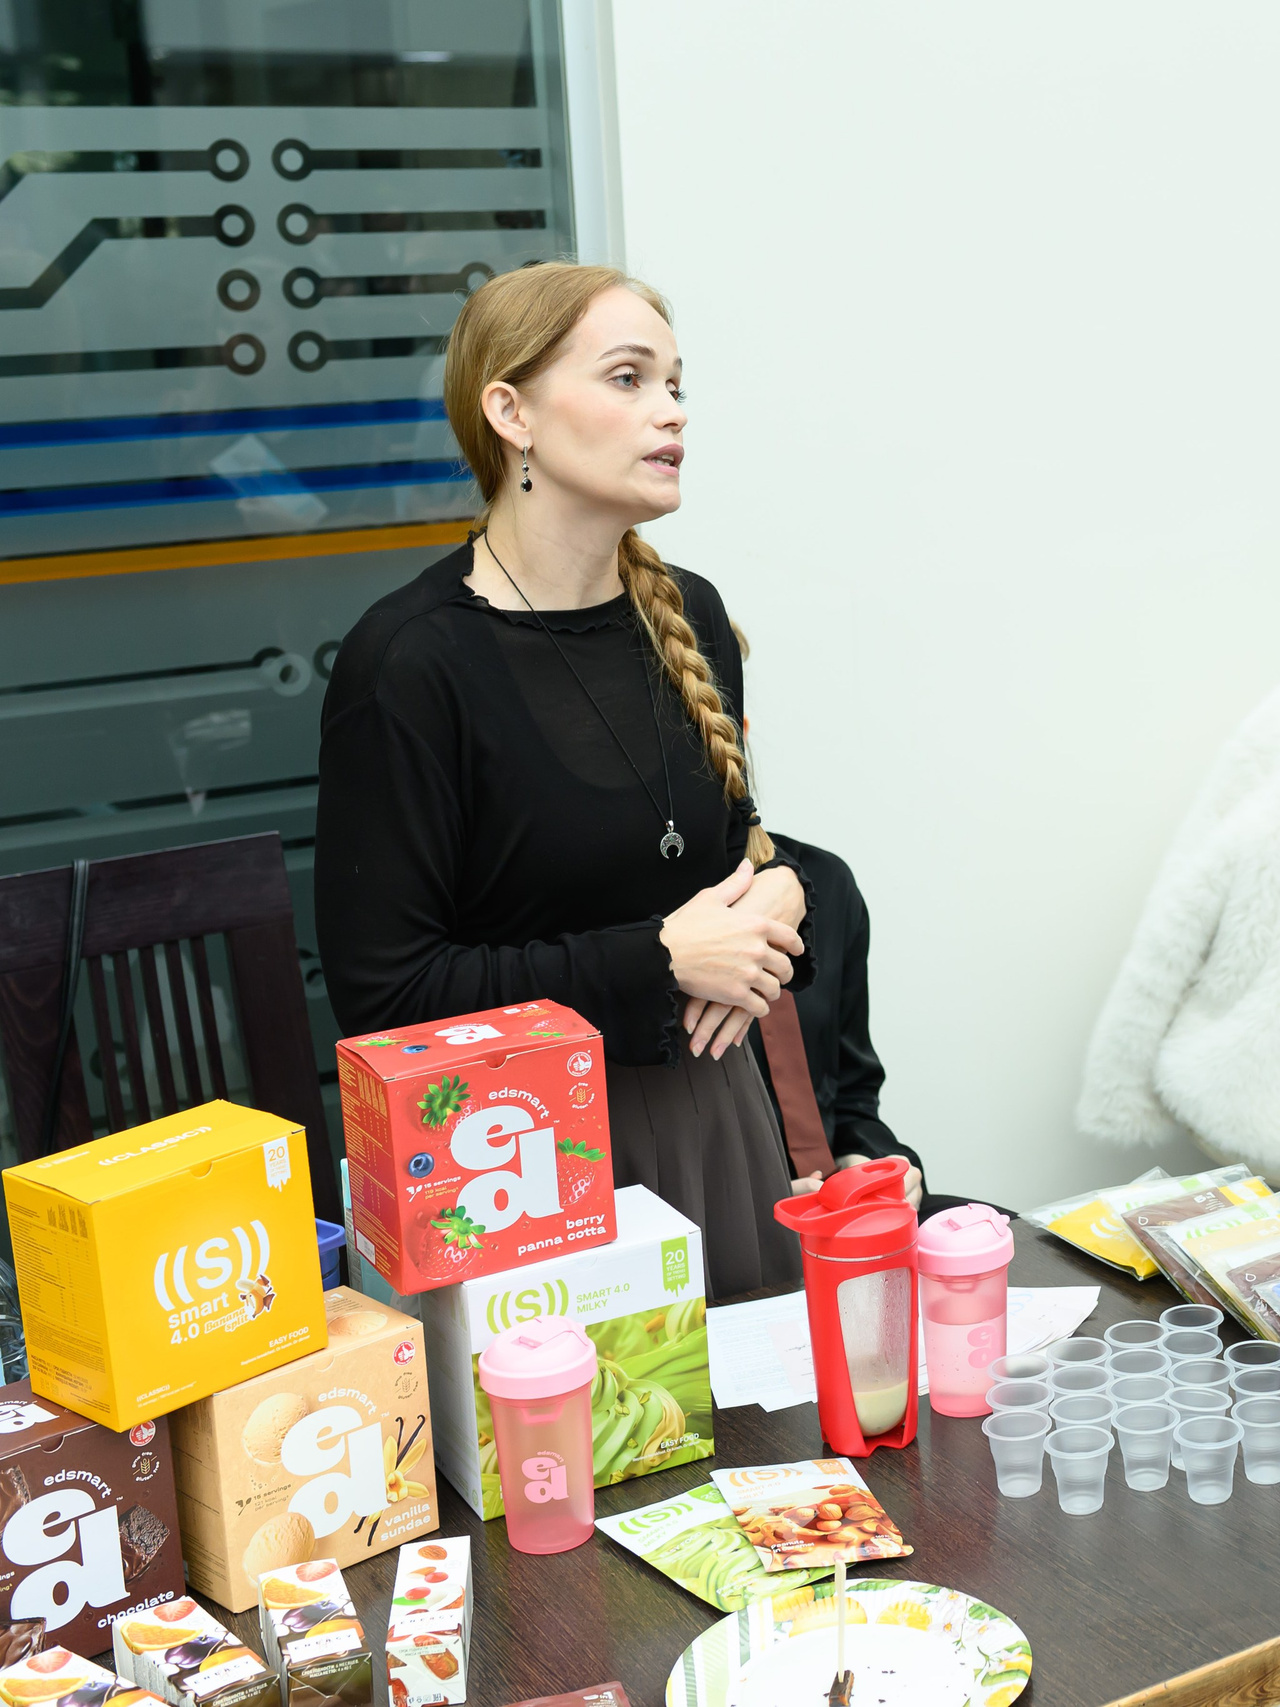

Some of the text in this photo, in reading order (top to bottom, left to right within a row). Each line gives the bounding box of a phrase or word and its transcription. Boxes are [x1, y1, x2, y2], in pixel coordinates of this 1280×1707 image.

[488, 1087, 550, 1119] edsmart
[268, 1145, 286, 1162] 20
[433, 1175, 462, 1187] servings
[566, 1213, 606, 1230] berry
[517, 1225, 607, 1256] panna cotta
[665, 1249, 685, 1265] 20
[666, 1263, 686, 1272] YEARS
[576, 1283, 631, 1304] SMART 4.0
[168, 1291, 230, 1329] smart
[576, 1298, 609, 1314] MILKY
[204, 1307, 247, 1334] Banana
[225, 1314, 252, 1332] split
[170, 1322, 200, 1345] 4.0
[269, 1326, 310, 1348] EASY FOOD
[317, 1386, 378, 1416] edsmart
[660, 1433, 700, 1449] EASY FOOD
[43, 1469, 112, 1499] edsmart
[263, 1483, 292, 1498] servings
[384, 1503, 431, 1527] vanilla
[380, 1514, 431, 1542] sundae
[97, 1590, 175, 1629] chocolate
